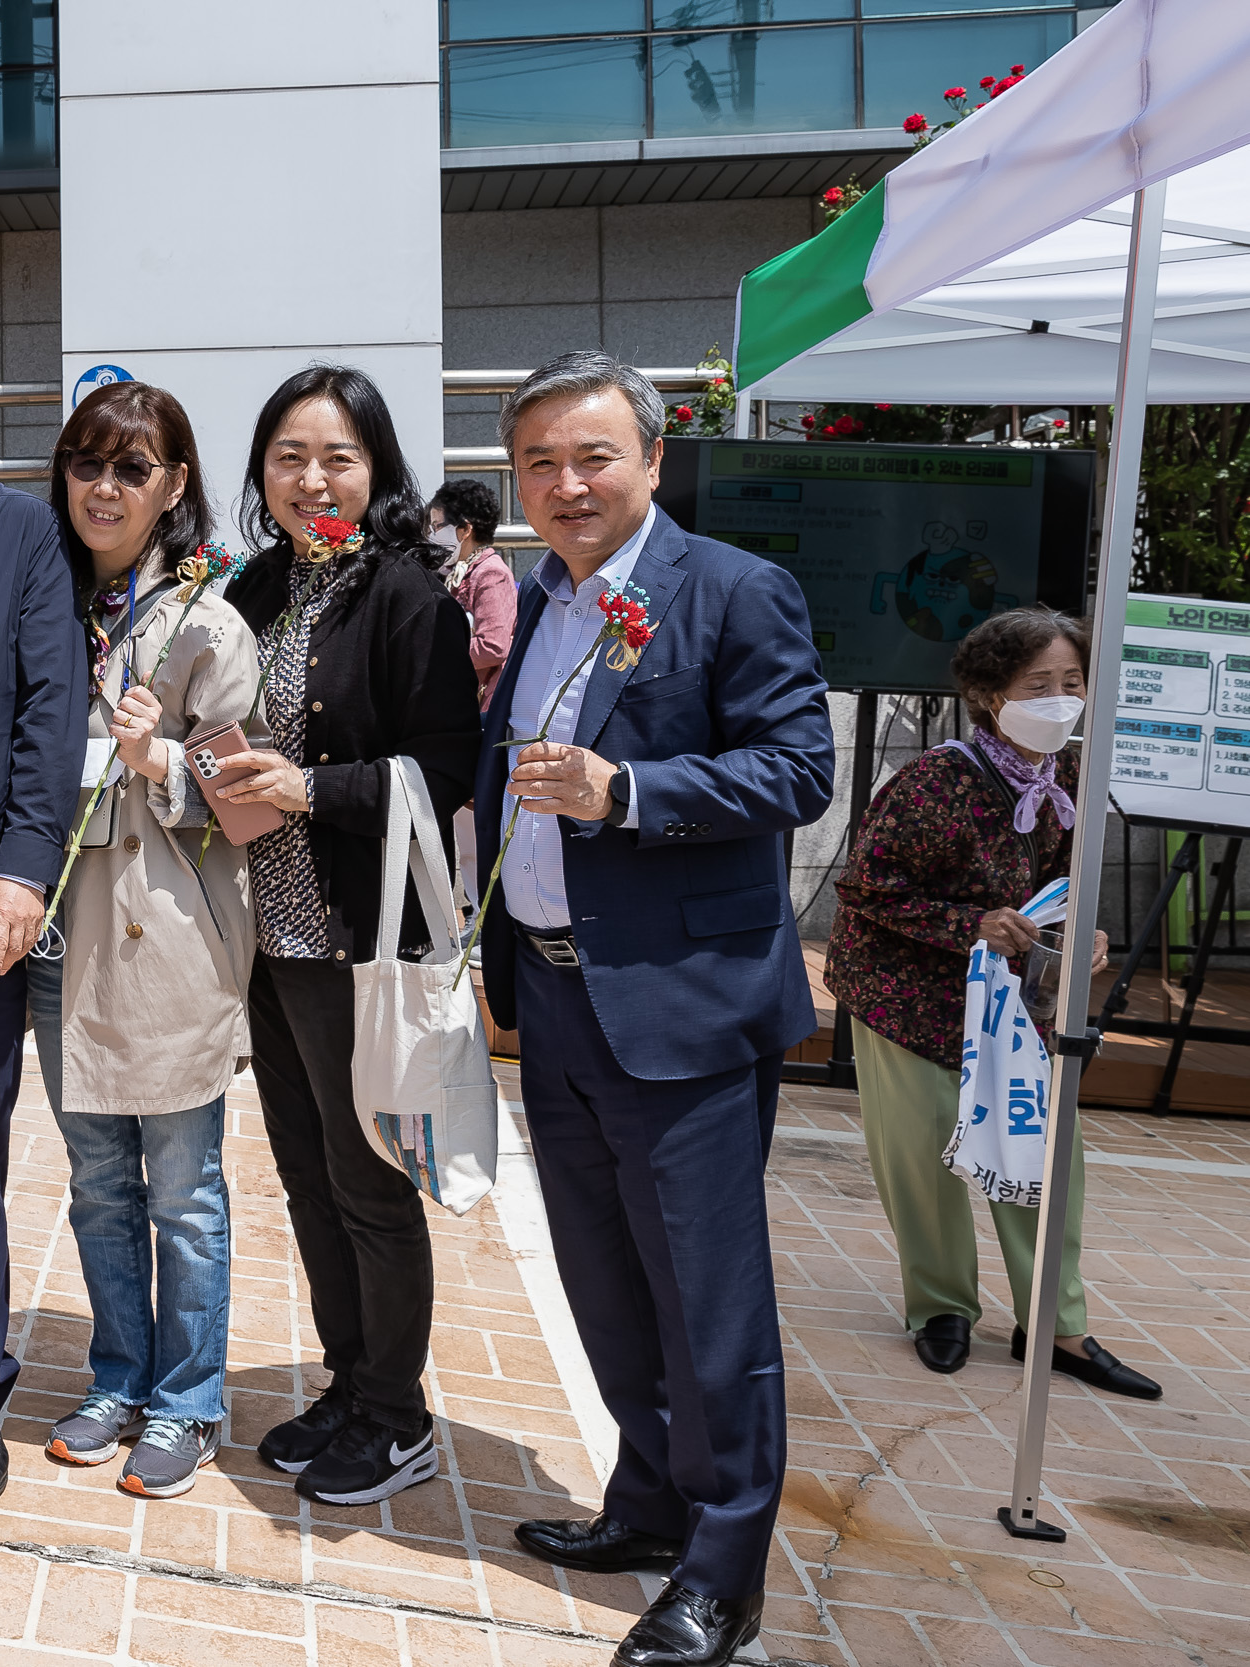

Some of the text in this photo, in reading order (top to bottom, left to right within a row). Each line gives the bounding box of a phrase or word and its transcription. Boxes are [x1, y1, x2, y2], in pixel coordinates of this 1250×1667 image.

[826, 456, 859, 472] 인해
[923, 459, 935, 474] 수
[938, 460, 963, 476] 있는
[1167, 606, 1205, 629] 노인
